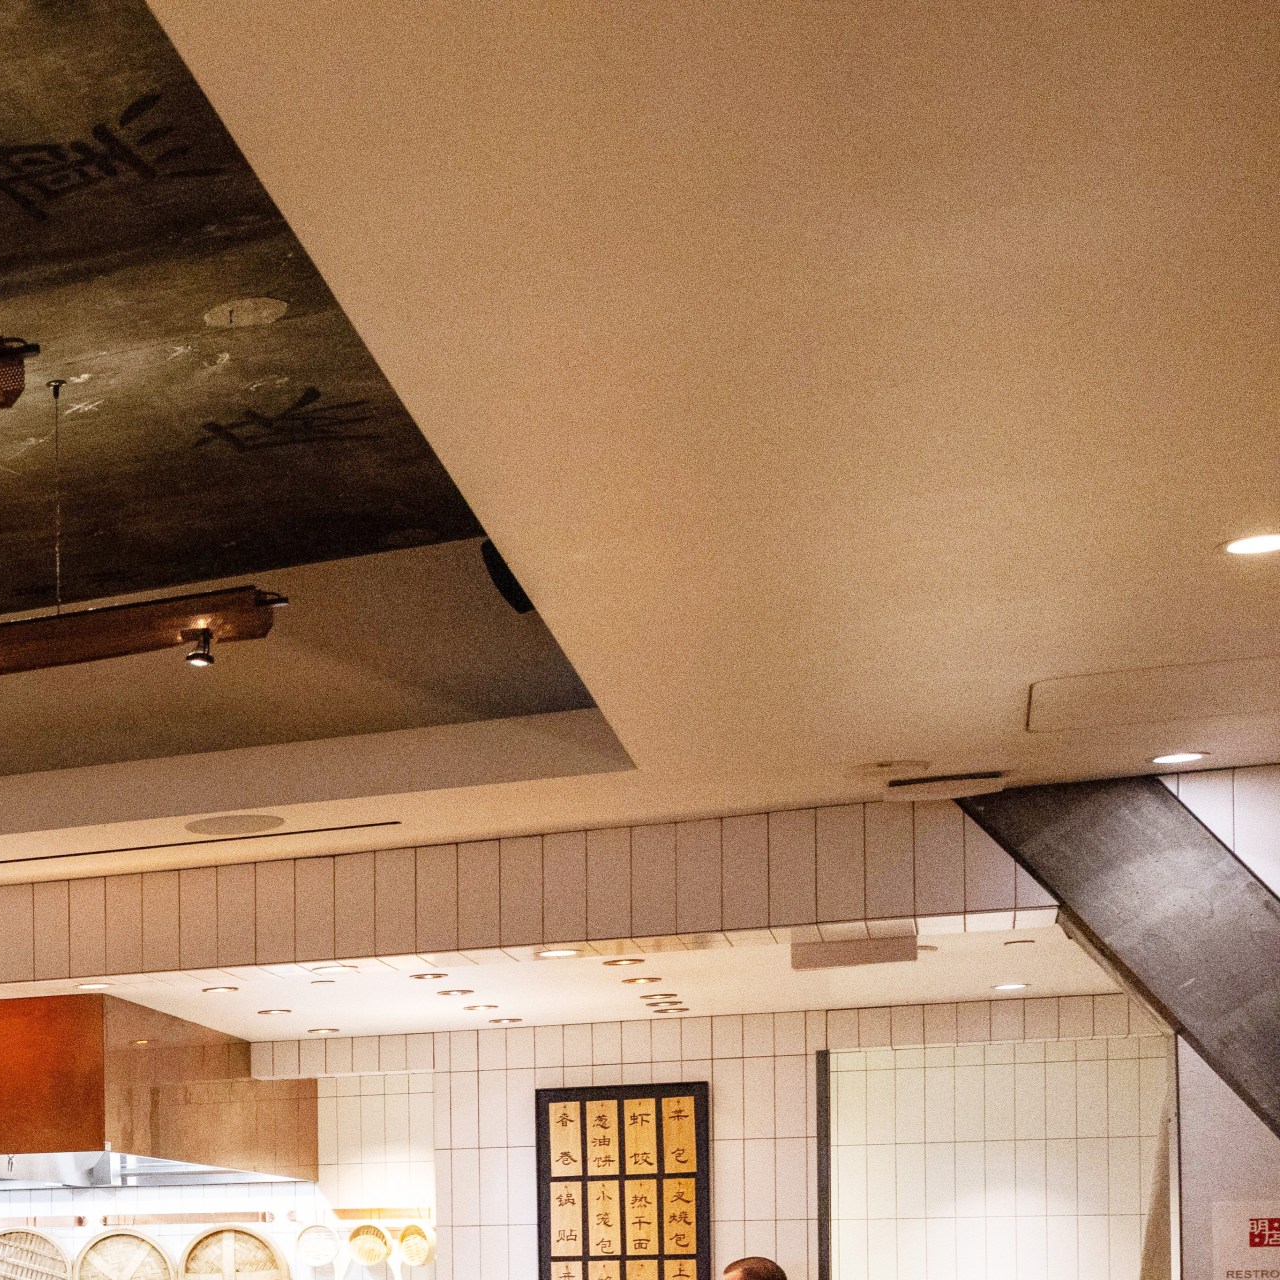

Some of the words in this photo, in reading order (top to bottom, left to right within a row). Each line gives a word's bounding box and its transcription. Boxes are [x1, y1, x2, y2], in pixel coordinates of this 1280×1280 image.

[629, 1113, 654, 1166] 虾饺
[556, 1193, 578, 1243] 锅贴
[595, 1190, 615, 1254] 小笼包
[630, 1193, 653, 1250] 热干面
